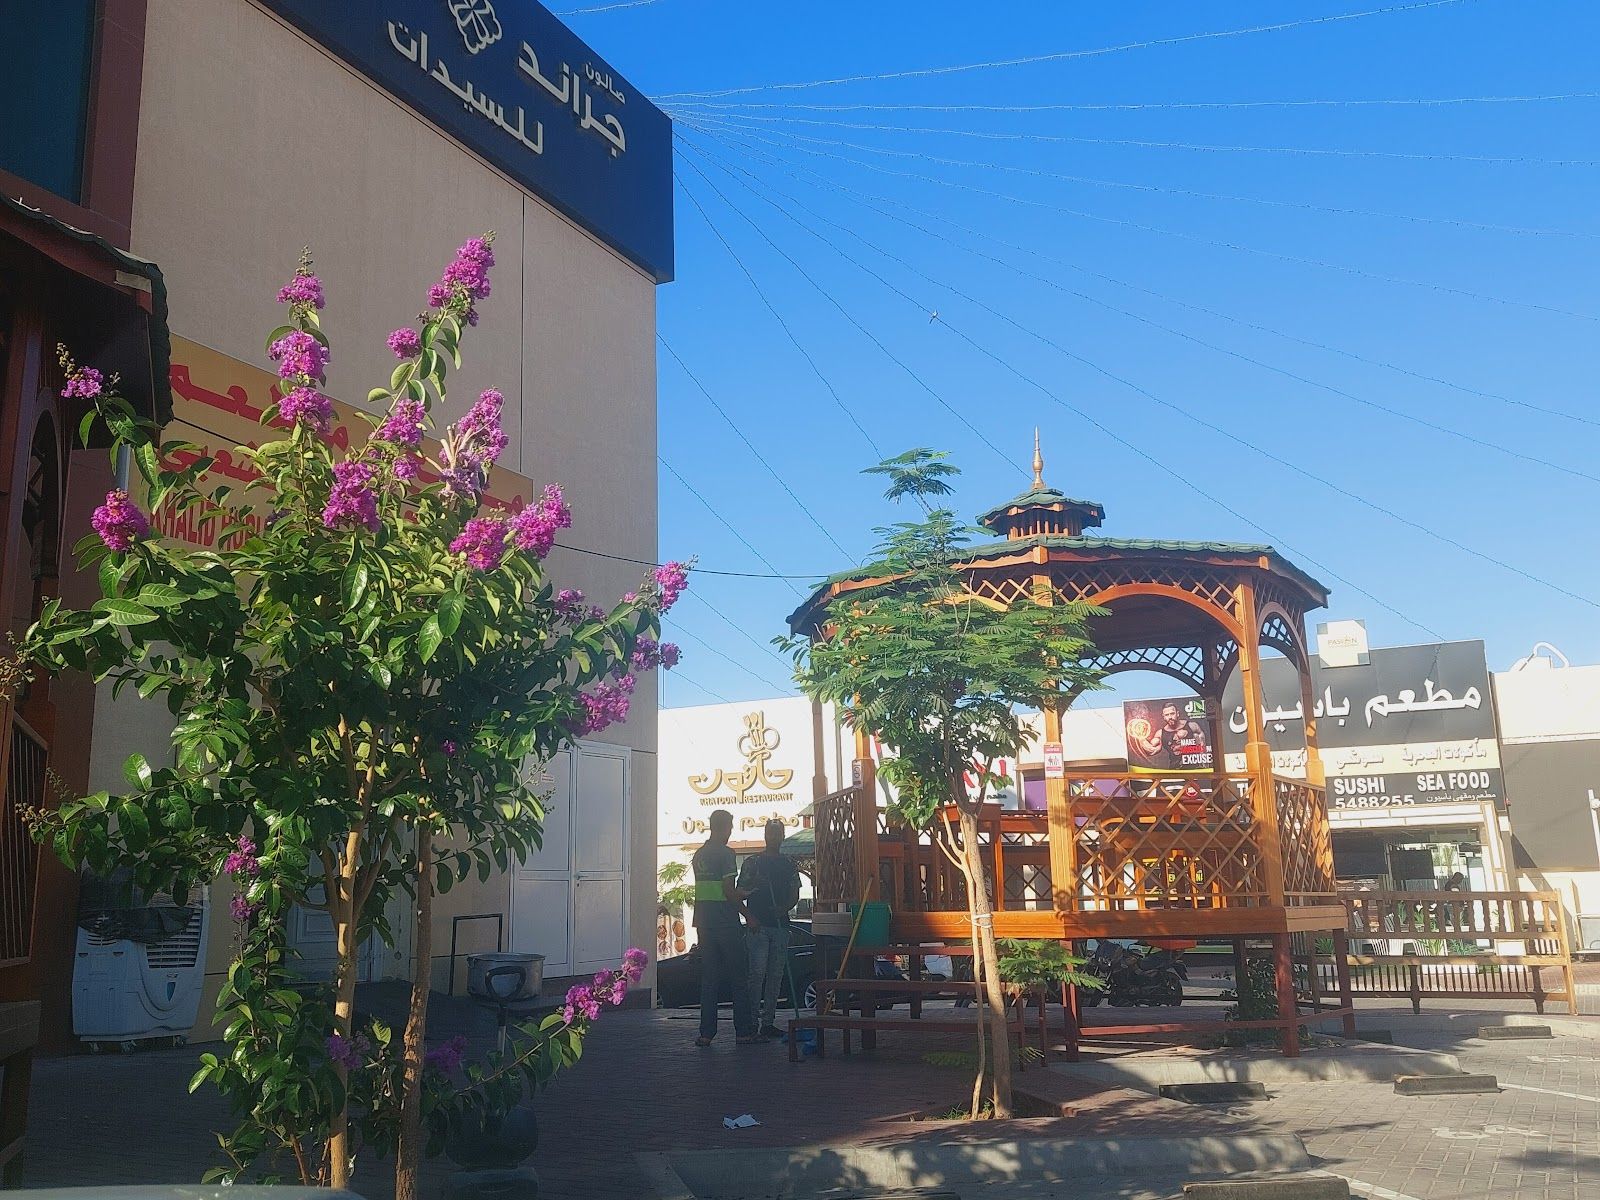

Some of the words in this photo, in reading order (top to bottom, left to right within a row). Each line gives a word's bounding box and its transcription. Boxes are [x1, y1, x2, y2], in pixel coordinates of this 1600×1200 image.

[387, 20, 544, 154] للسيدات
[518, 40, 626, 157] جراند
[585, 62, 626, 105] صالون
[1229, 685, 1351, 733] باسين
[1364, 678, 1482, 728] مطعم
[743, 792, 794, 804] RESTAURANT
[1333, 776, 1386, 795] SUSHI
[1335, 794, 1415, 810] 5488255
[1416, 773, 1446, 792] SEA
[1448, 771, 1490, 790] FOOD
